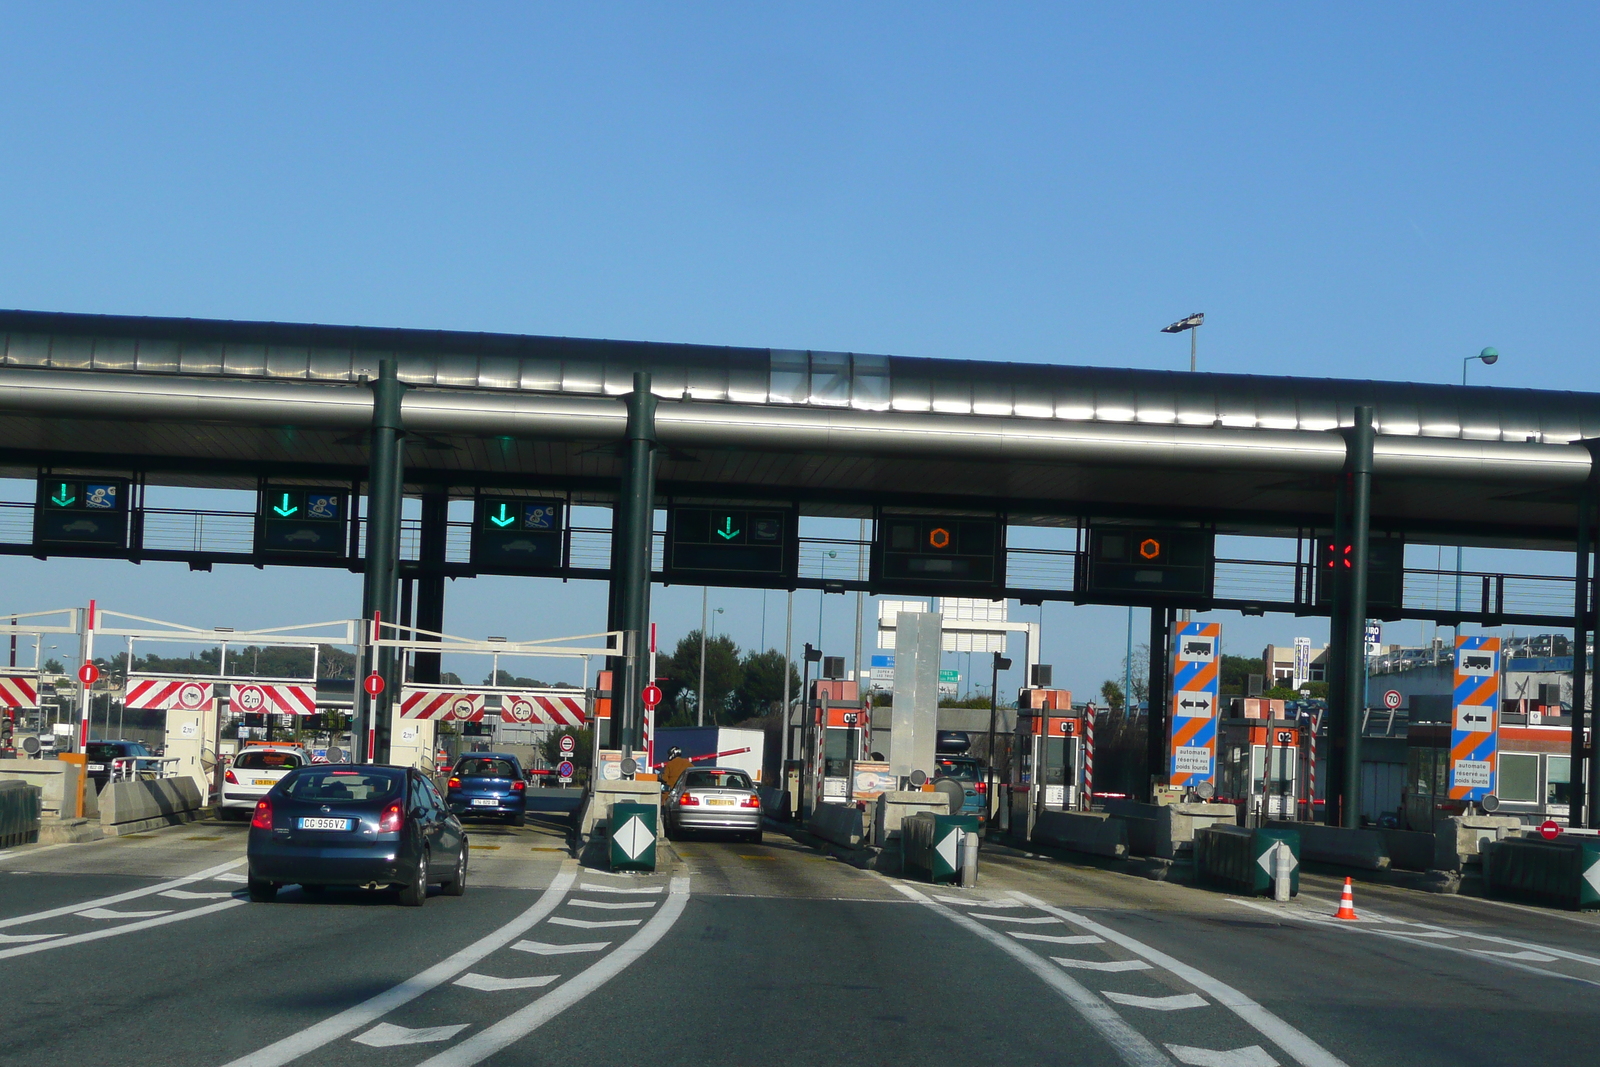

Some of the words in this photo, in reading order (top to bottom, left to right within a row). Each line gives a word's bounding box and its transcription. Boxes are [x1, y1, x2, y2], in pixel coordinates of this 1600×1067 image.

[1388, 695, 1398, 704] 70
[844, 713, 857, 723] 05
[1060, 722, 1074, 732] 03
[1278, 732, 1292, 742] 02
[1583, 733, 1588, 742] 1
[1458, 762, 1486, 770] automate
[304, 818, 315, 828] CG
